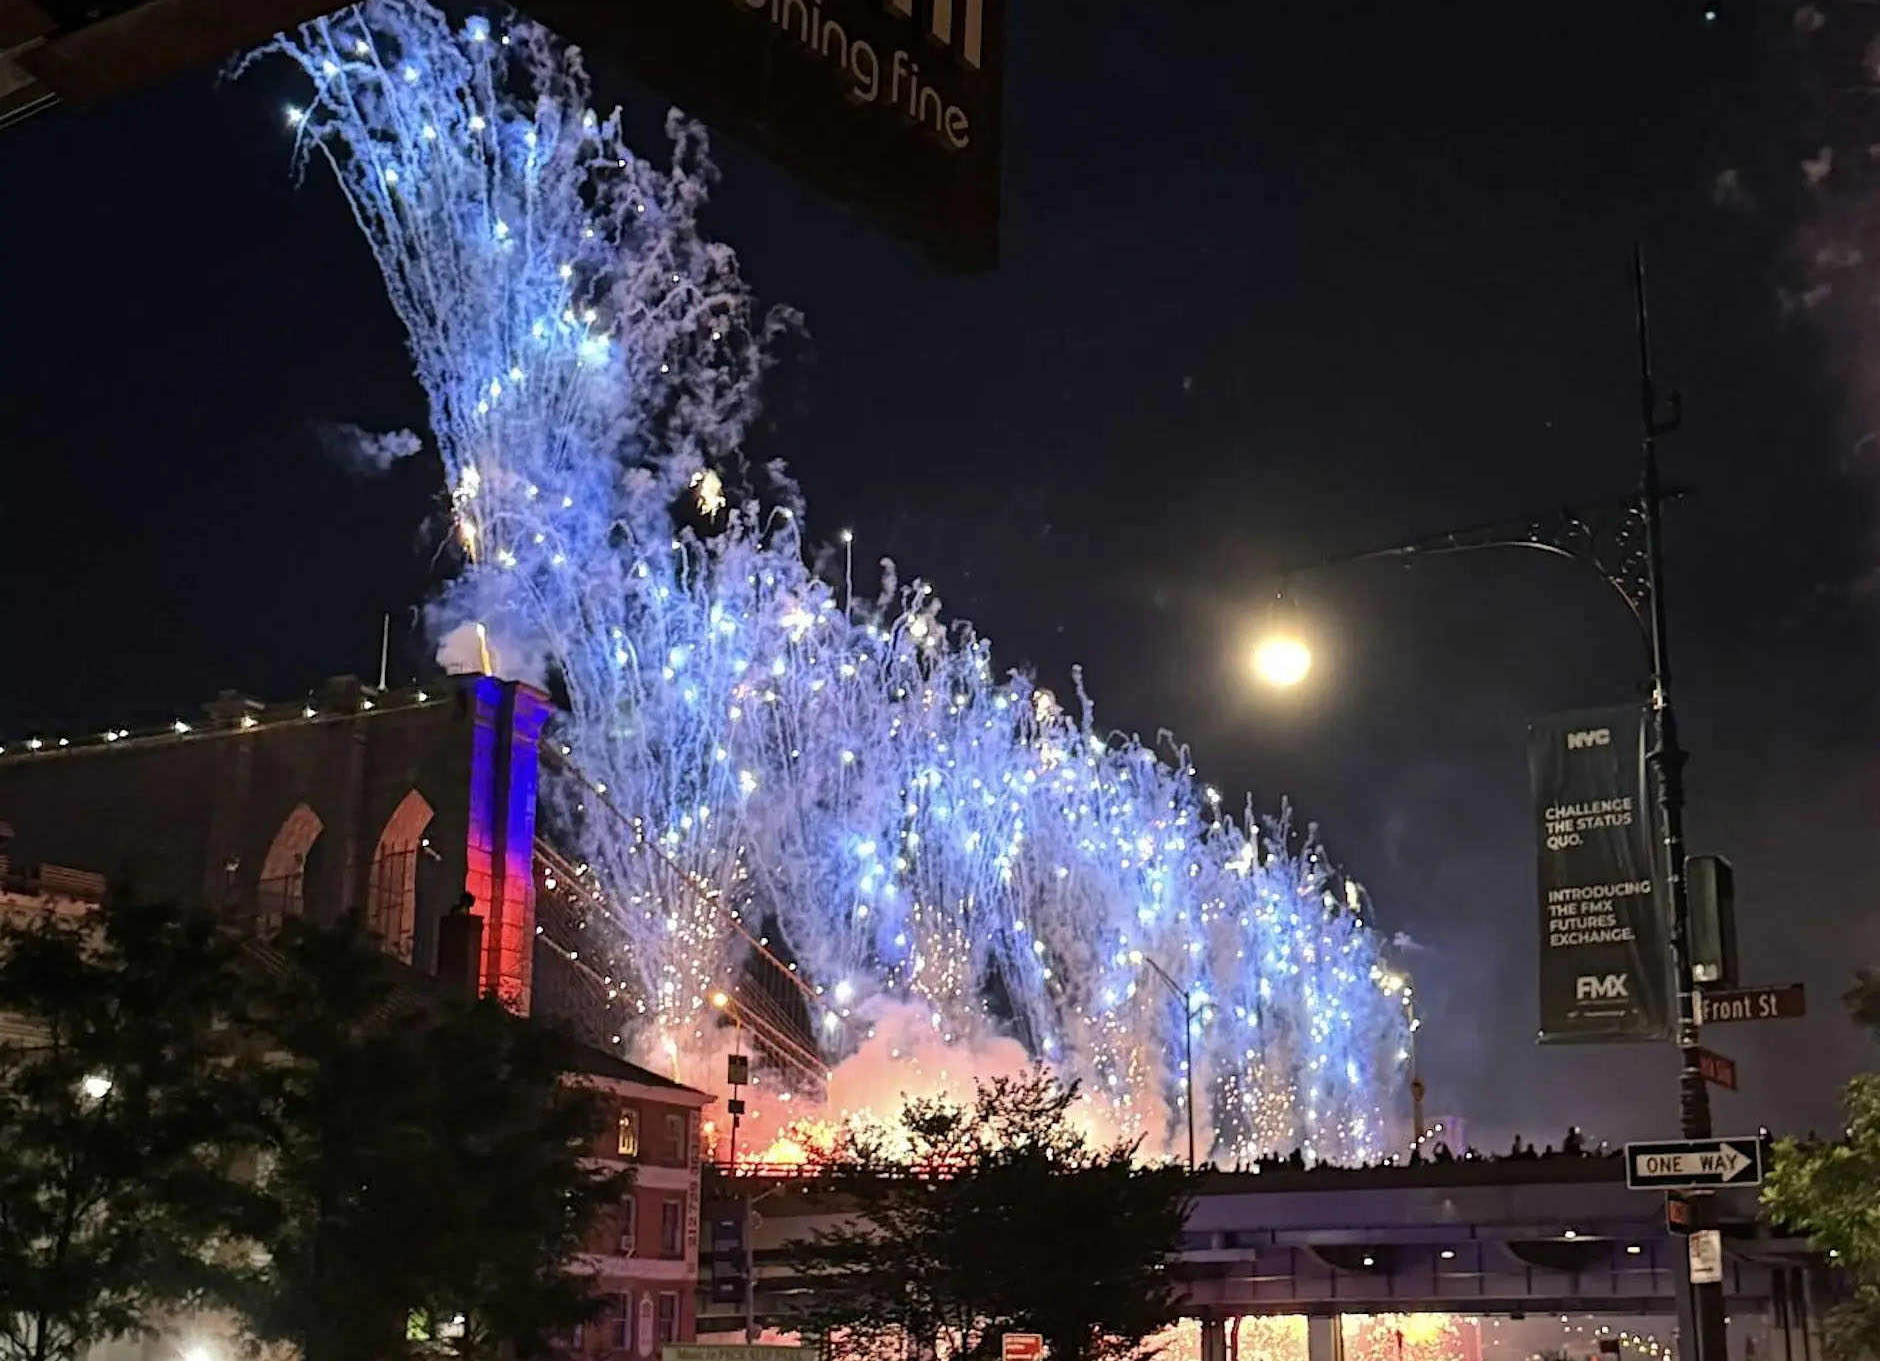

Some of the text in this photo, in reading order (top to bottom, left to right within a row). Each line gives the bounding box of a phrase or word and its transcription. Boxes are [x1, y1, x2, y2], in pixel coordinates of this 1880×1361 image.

[890, 50, 970, 150] fine
[1567, 728, 1611, 750] NYC
[1545, 797, 1633, 820] CHALLENGE
[1546, 812, 1633, 835] THE STATUS
[1546, 833, 1584, 851] QUO.
[1548, 880, 1652, 903] INTRODUCING
[1549, 900, 1613, 918] THE FMX
[1549, 914, 1617, 933] FUTURES
[1550, 928, 1636, 947] EXCHANGE.
[1576, 973, 1630, 1000] FMX
[1703, 993, 1778, 1021] Front St
[1646, 1154, 1738, 1174] ONE WAY
